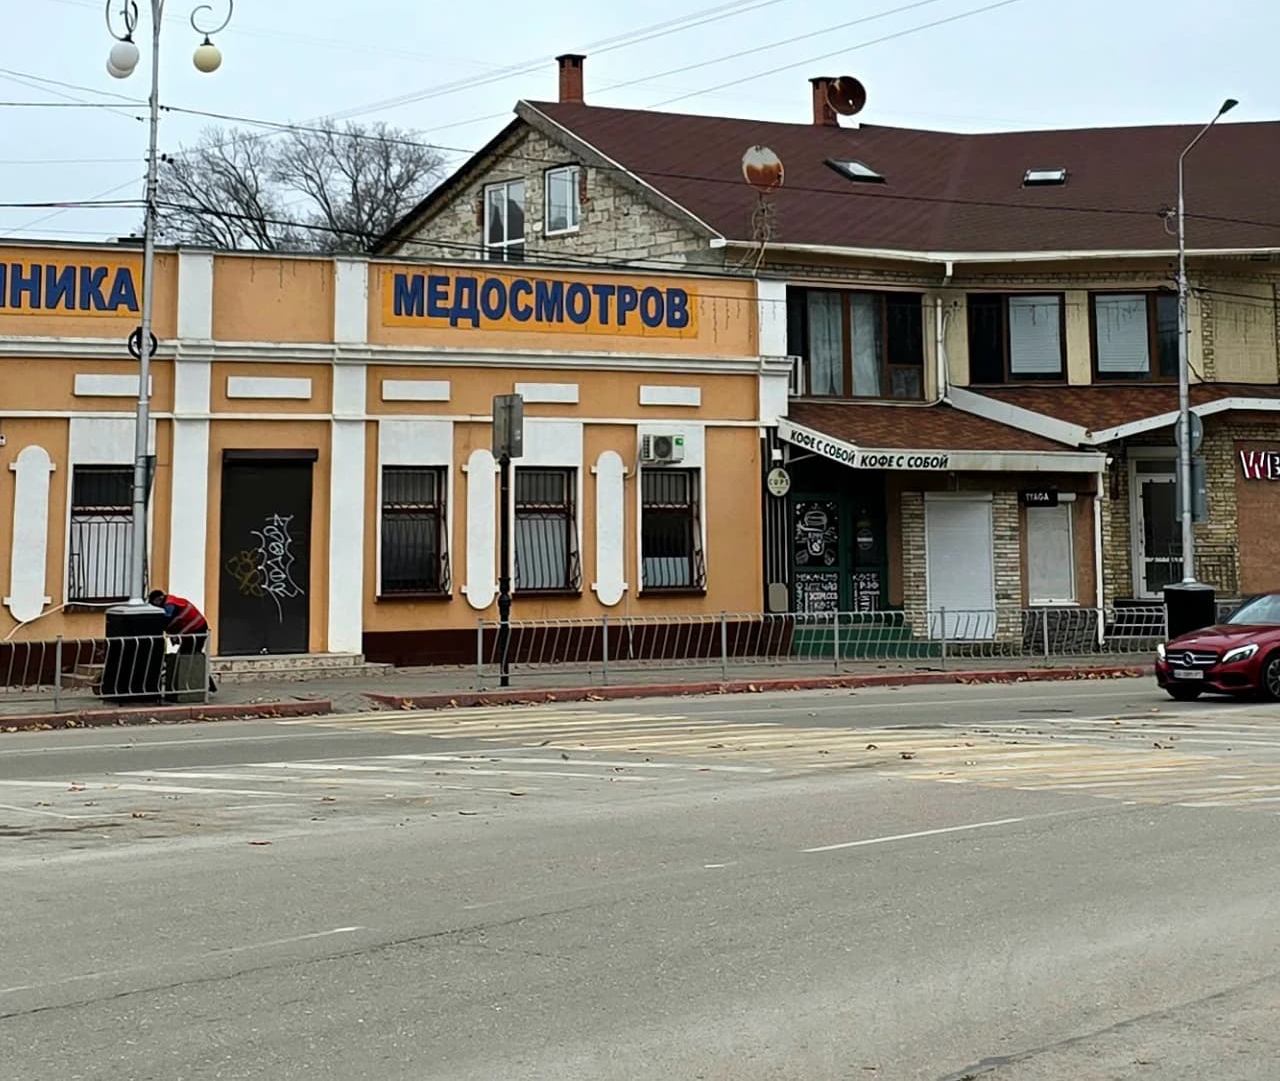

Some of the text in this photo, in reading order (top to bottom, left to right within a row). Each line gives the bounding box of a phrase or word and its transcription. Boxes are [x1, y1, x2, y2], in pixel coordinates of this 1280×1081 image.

[393, 273, 690, 330] МЕДОСМОТРОВ
[790, 430, 856, 465] КОФЕ С СОБОЙ
[860, 454, 949, 469] КОФЕ С СОБОЙ
